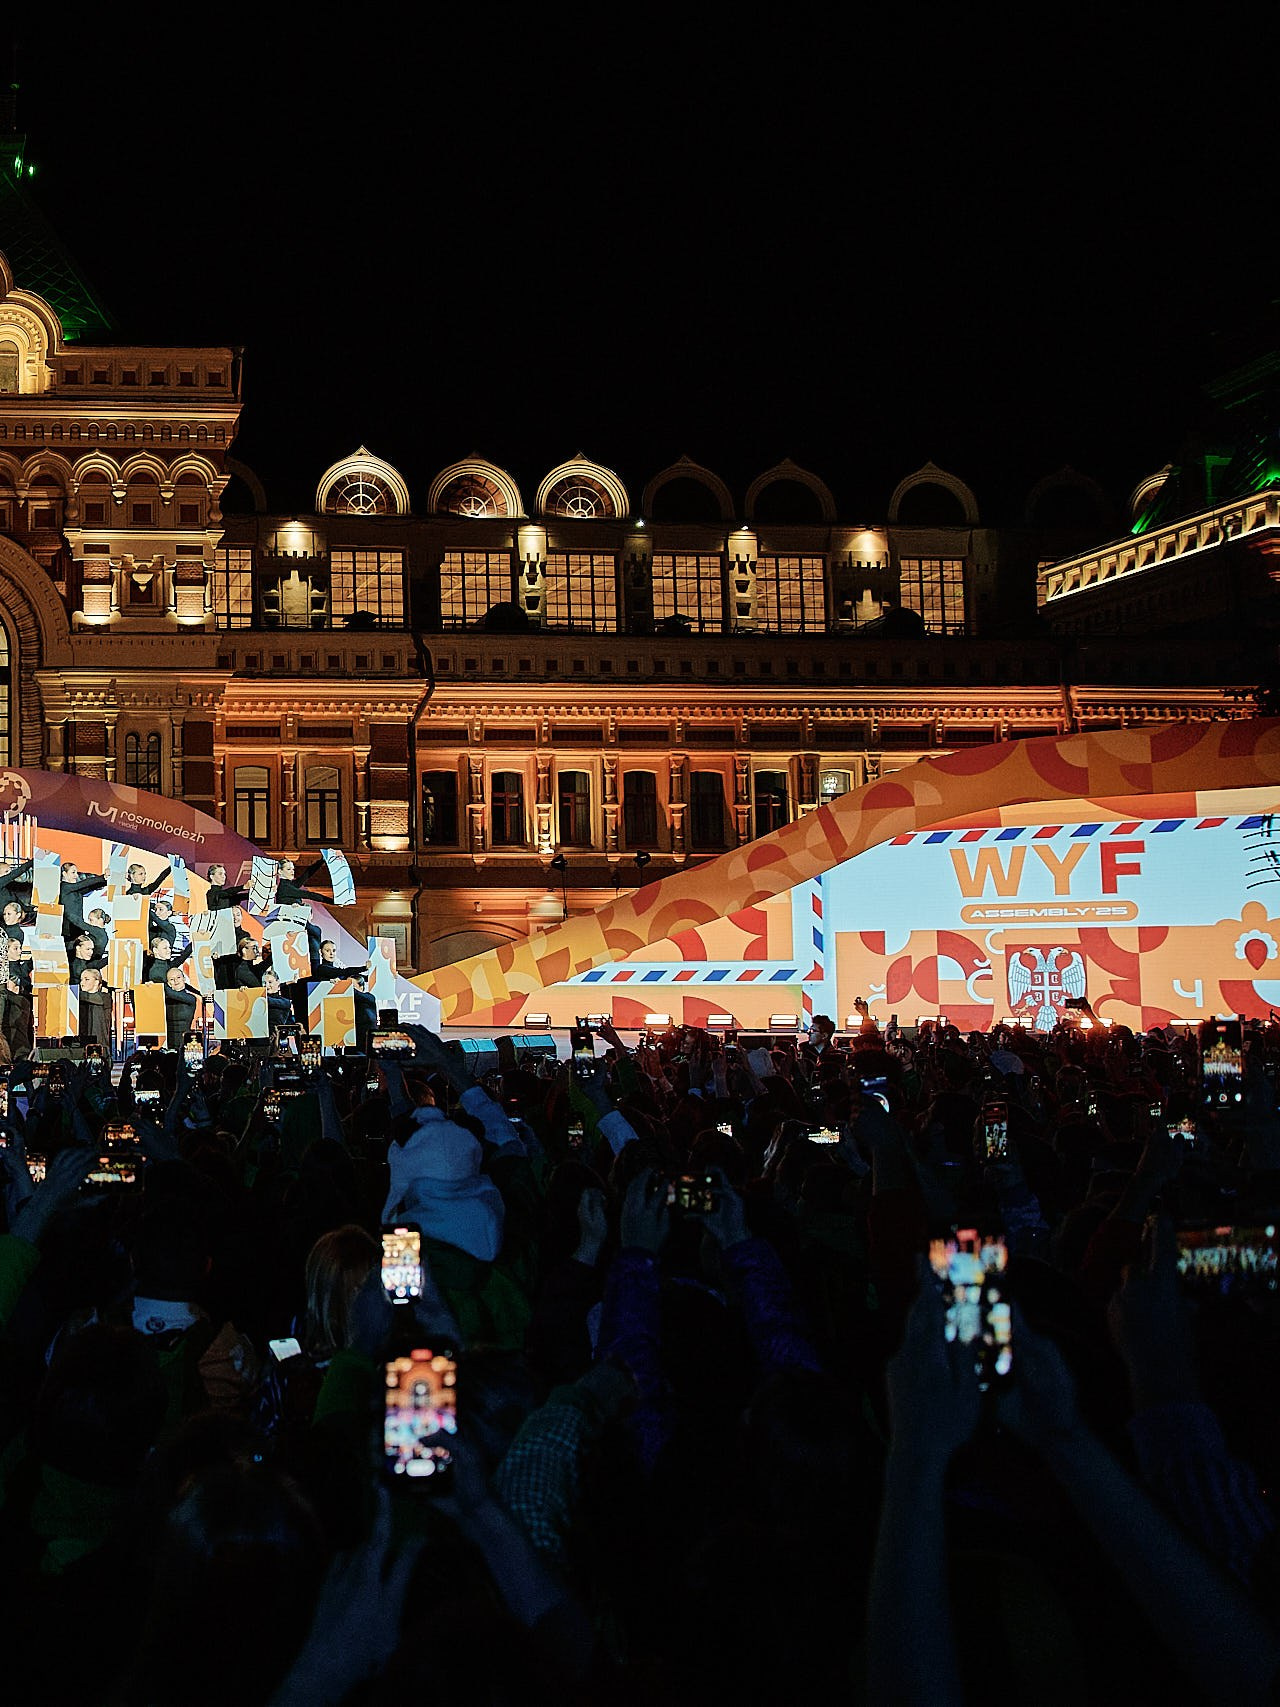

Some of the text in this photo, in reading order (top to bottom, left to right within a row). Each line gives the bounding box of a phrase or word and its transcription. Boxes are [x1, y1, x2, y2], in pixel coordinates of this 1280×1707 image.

[120, 810, 205, 844] rosmolodezh
[949, 840, 1146, 898] WYF
[970, 906, 1128, 918] ASSEMBLY'25
